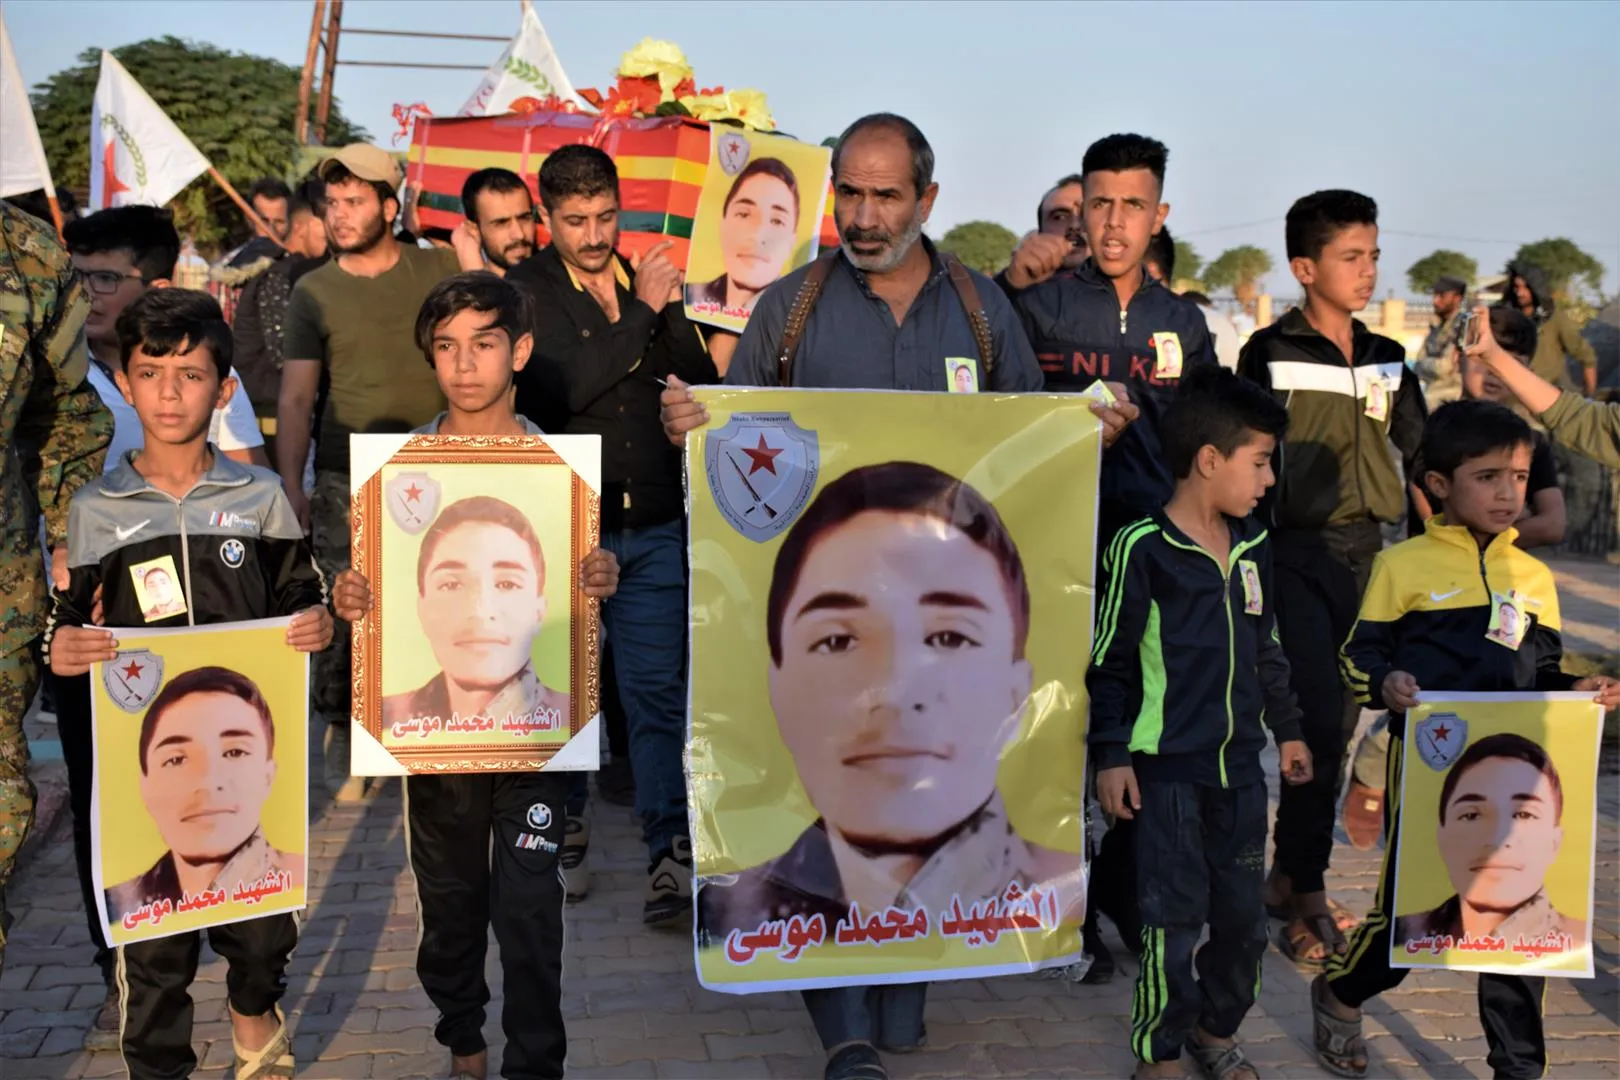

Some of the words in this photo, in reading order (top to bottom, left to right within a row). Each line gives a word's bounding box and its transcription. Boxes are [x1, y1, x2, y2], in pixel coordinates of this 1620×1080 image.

[392, 715, 441, 738] موسى
[446, 712, 495, 733] محمد
[501, 707, 561, 737] الشهيد
[177, 888, 226, 913] محمد
[232, 870, 292, 903] الشهيد
[123, 897, 171, 929] موسى
[835, 901, 930, 946] محمد
[939, 880, 1060, 948] الشهيد
[725, 912, 826, 964] موسى
[1406, 933, 1453, 955] موسى
[1458, 931, 1506, 952] محمد
[1512, 931, 1573, 957] الشهيد
